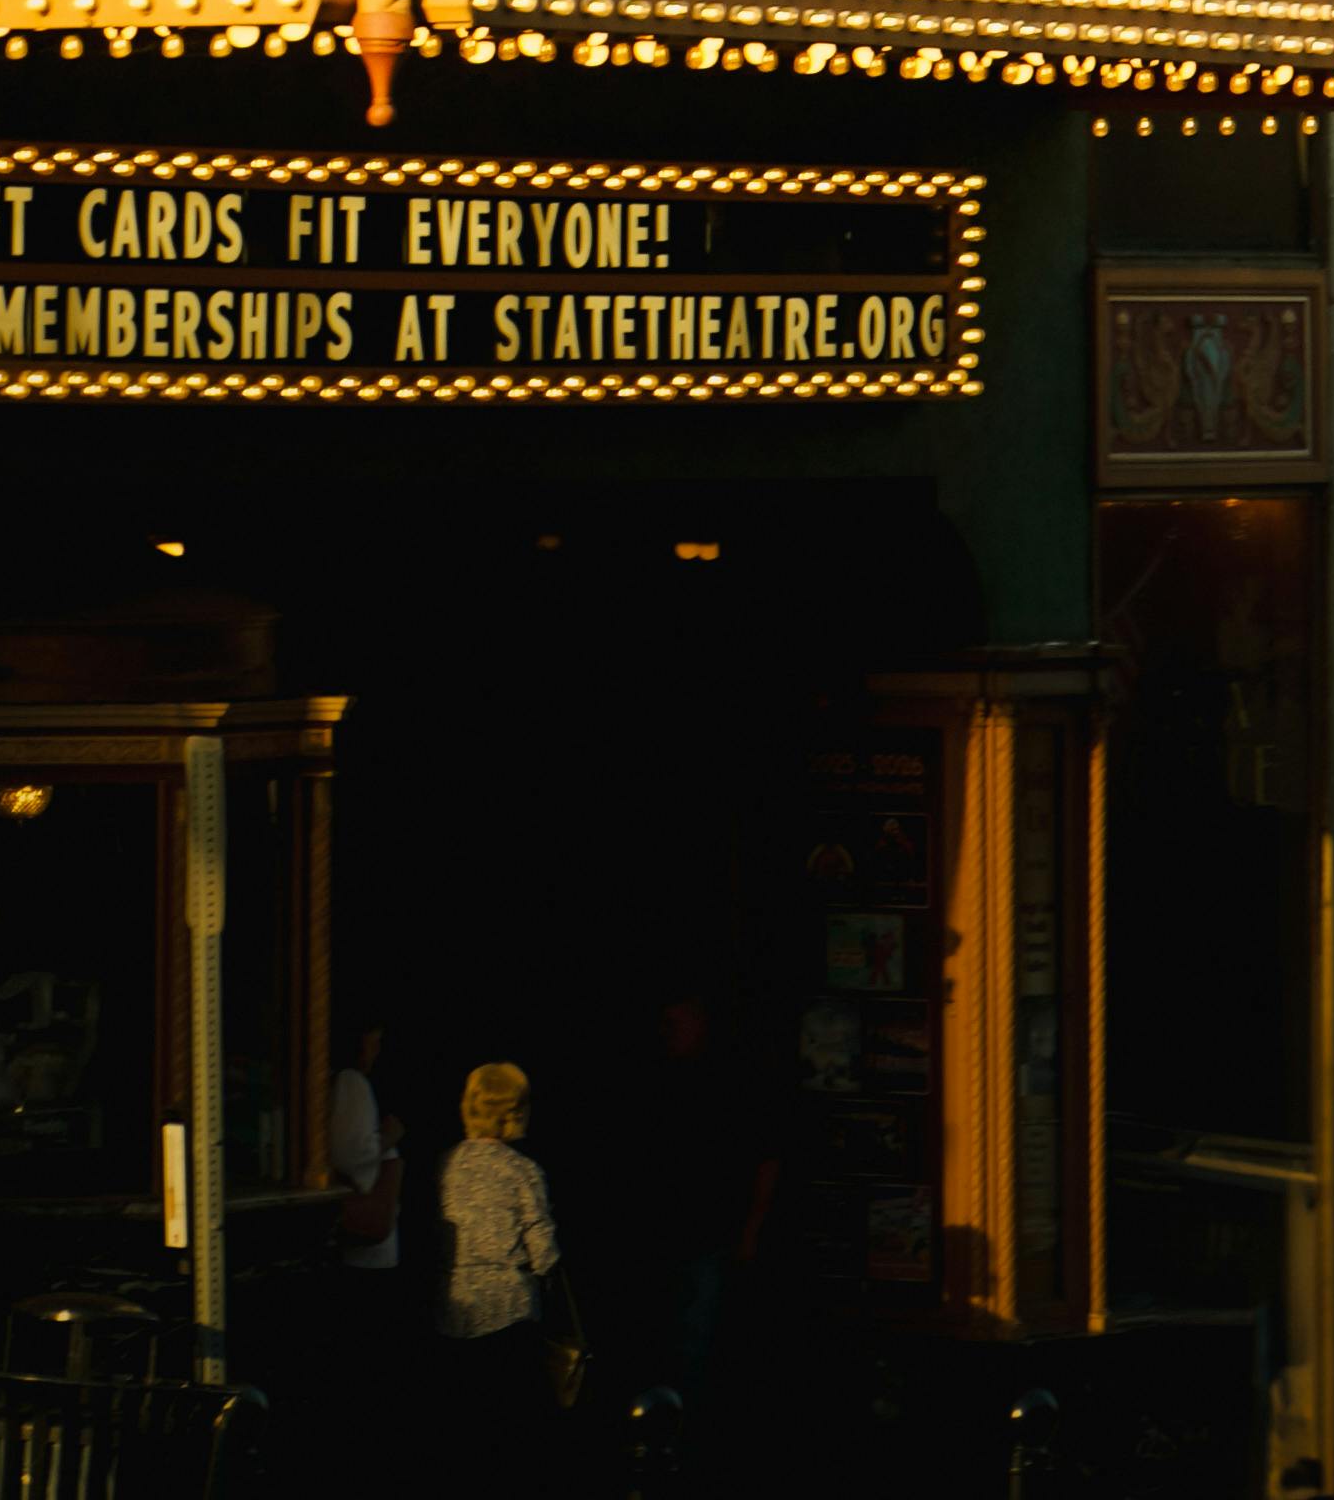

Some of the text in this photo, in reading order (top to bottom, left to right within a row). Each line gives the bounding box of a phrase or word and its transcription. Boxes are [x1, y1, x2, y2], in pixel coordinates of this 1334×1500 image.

[78, 187, 244, 263] CARDS
[288, 194, 366, 265] FIT
[408, 198, 670, 269] EVERYONE!
[394, 294, 456, 362] AT
[493, 294, 945, 362] STATETHEATRE.ORG
